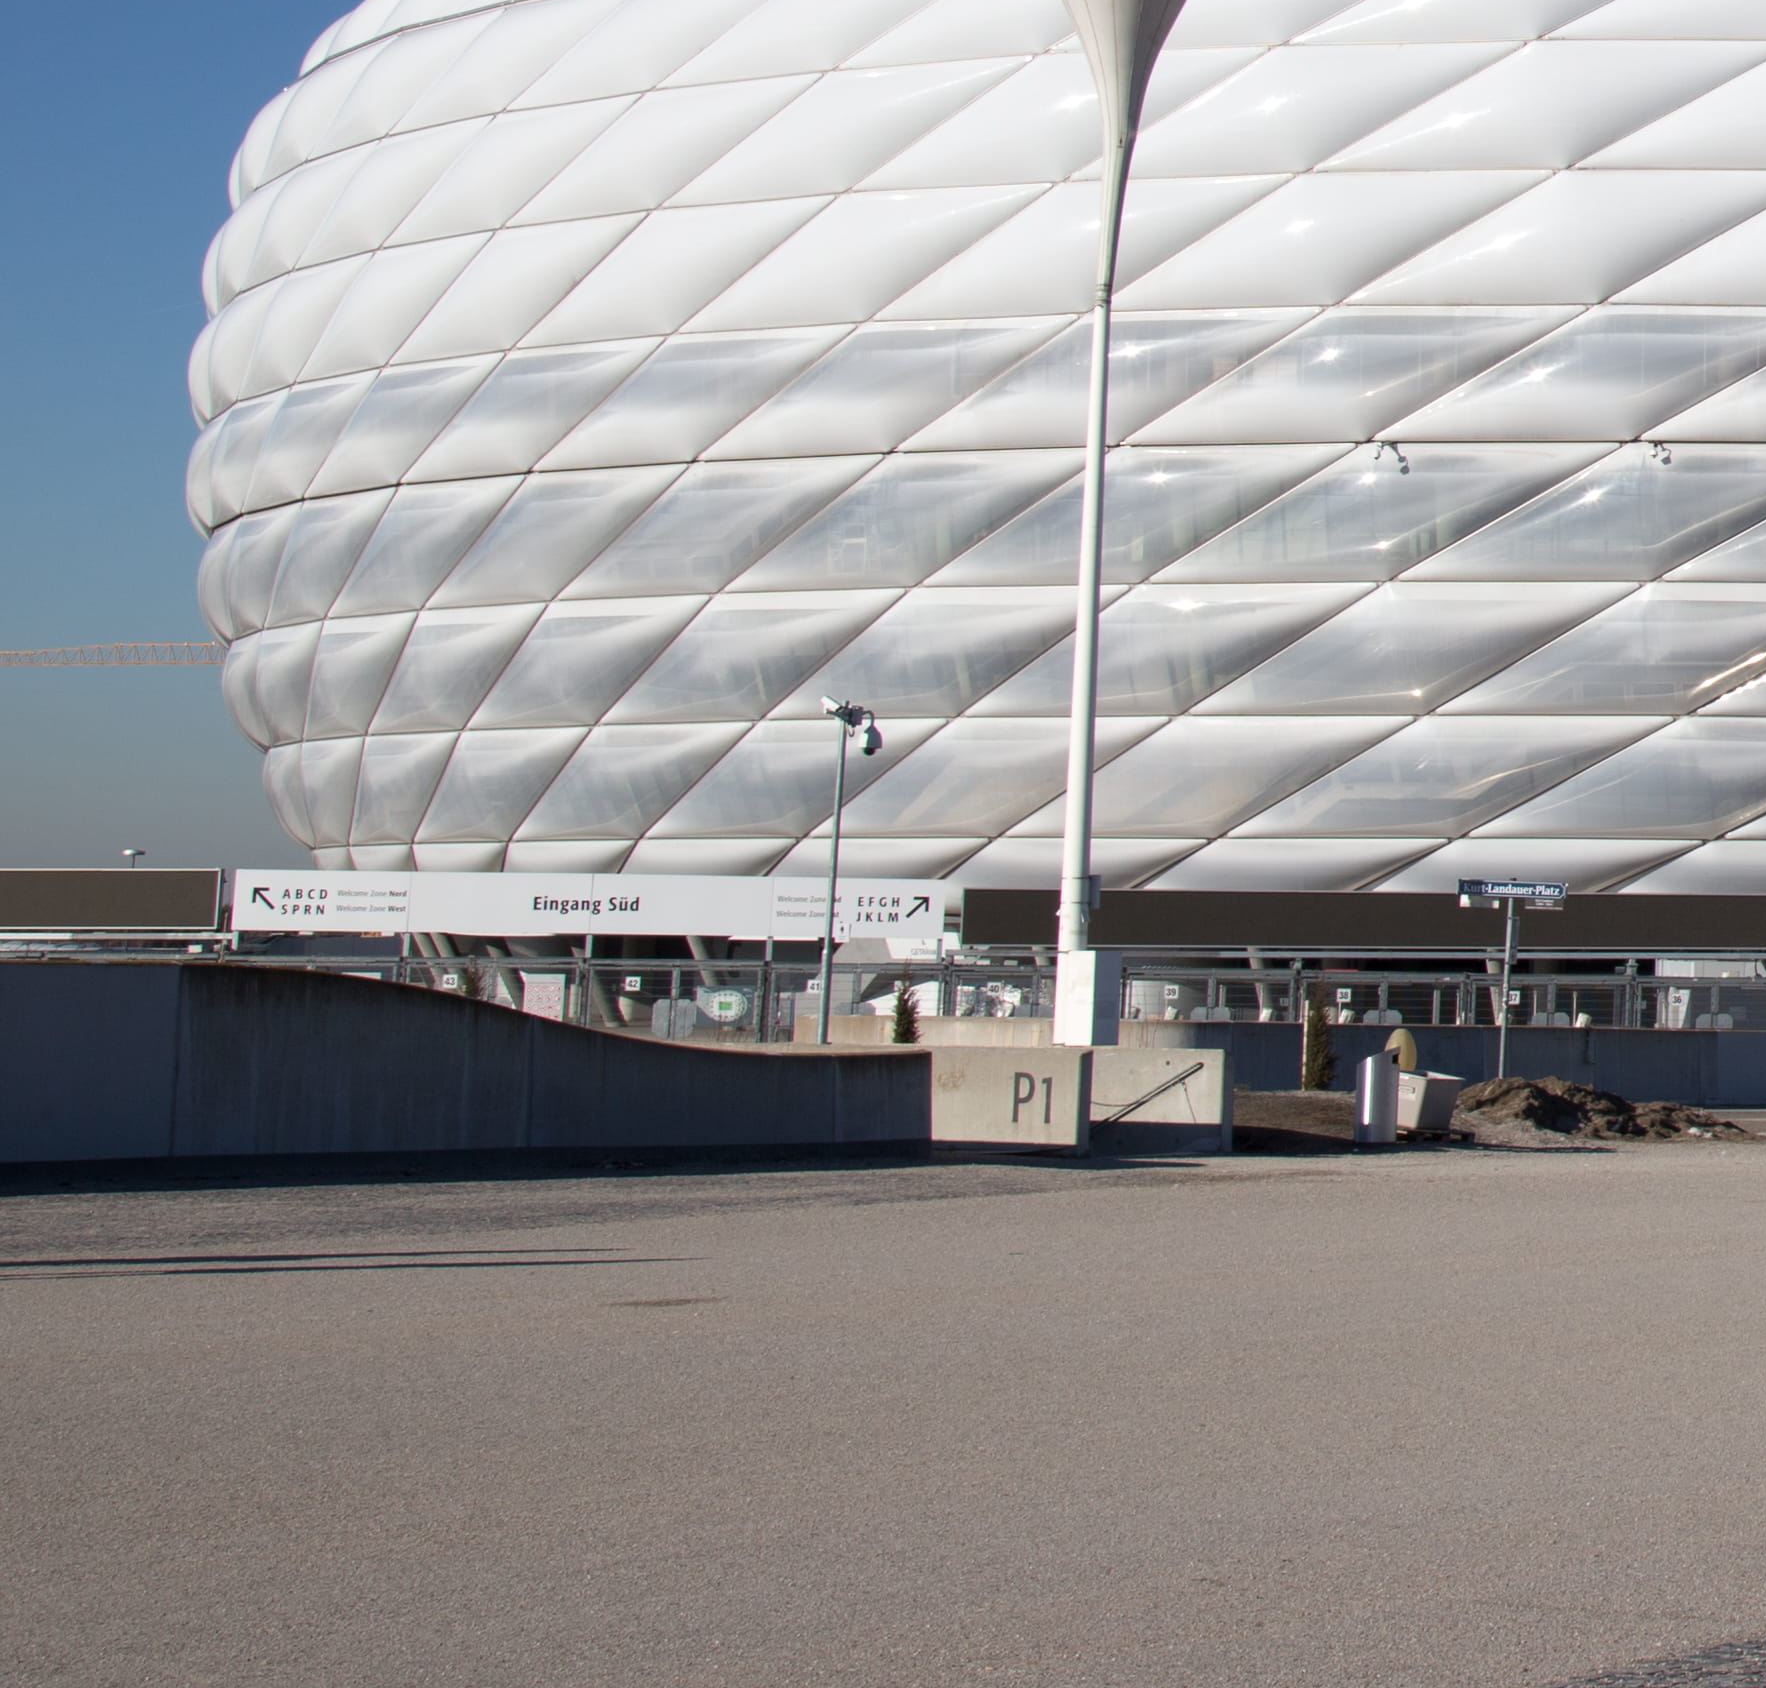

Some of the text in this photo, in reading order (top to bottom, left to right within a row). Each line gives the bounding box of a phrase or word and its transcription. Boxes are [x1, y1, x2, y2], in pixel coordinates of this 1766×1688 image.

[389, 890, 407, 898] Nord
[1463, 883, 1560, 896] Kurt-Landauer-Platz
[533, 896, 640, 915] Eingang Süd
[444, 976, 456, 986] 43
[627, 979, 639, 988] 42
[809, 983, 820, 991] 41
[988, 984, 1000, 993] 40
[1165, 987, 1177, 997] 39
[1338, 991, 1349, 1000] 38
[1672, 994, 1681, 1003] 36
[1012, 1071, 1053, 1124] P1
